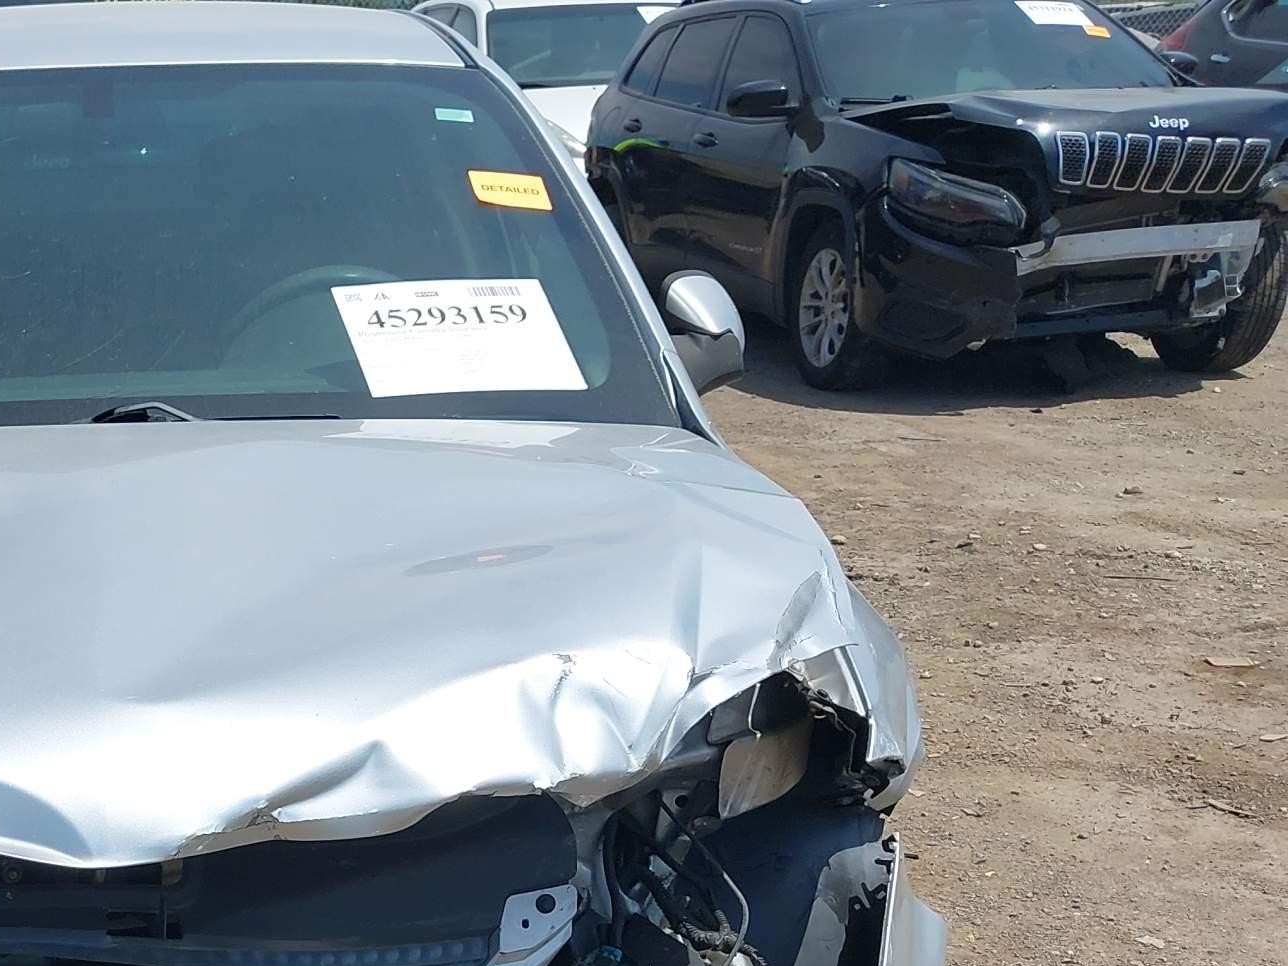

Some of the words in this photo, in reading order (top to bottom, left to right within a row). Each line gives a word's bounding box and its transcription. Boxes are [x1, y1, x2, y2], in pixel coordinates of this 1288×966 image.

[1148, 114, 1190, 130] Jeep
[480, 184, 540, 196] DETAILED
[367, 303, 527, 328] 45293159
